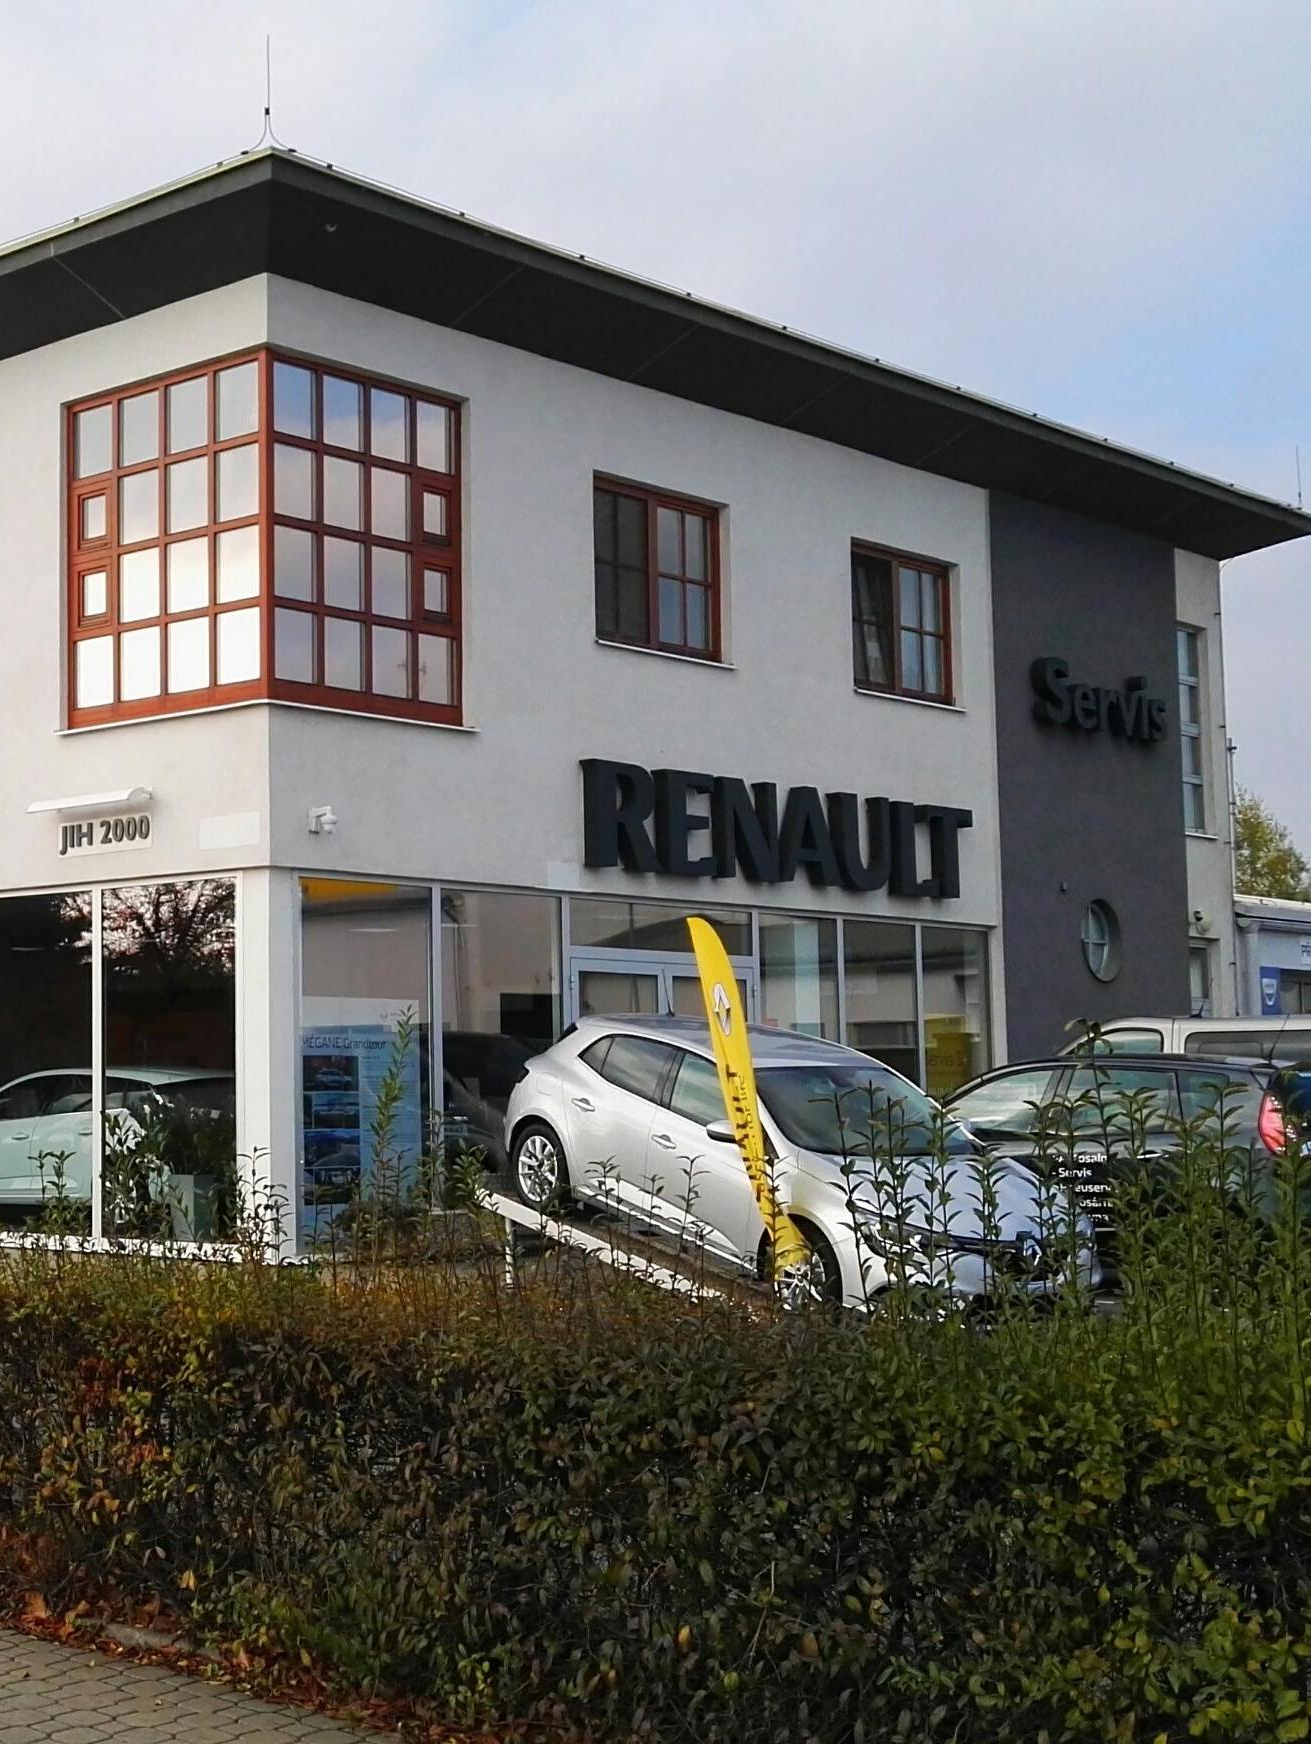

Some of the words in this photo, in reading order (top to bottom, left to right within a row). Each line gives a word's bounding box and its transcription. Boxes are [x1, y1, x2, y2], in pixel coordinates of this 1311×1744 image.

[1029, 656, 1167, 742] Servis
[59, 822, 93, 856] JIH
[100, 815, 150, 844] 2000
[578, 758, 973, 899] RENAULT
